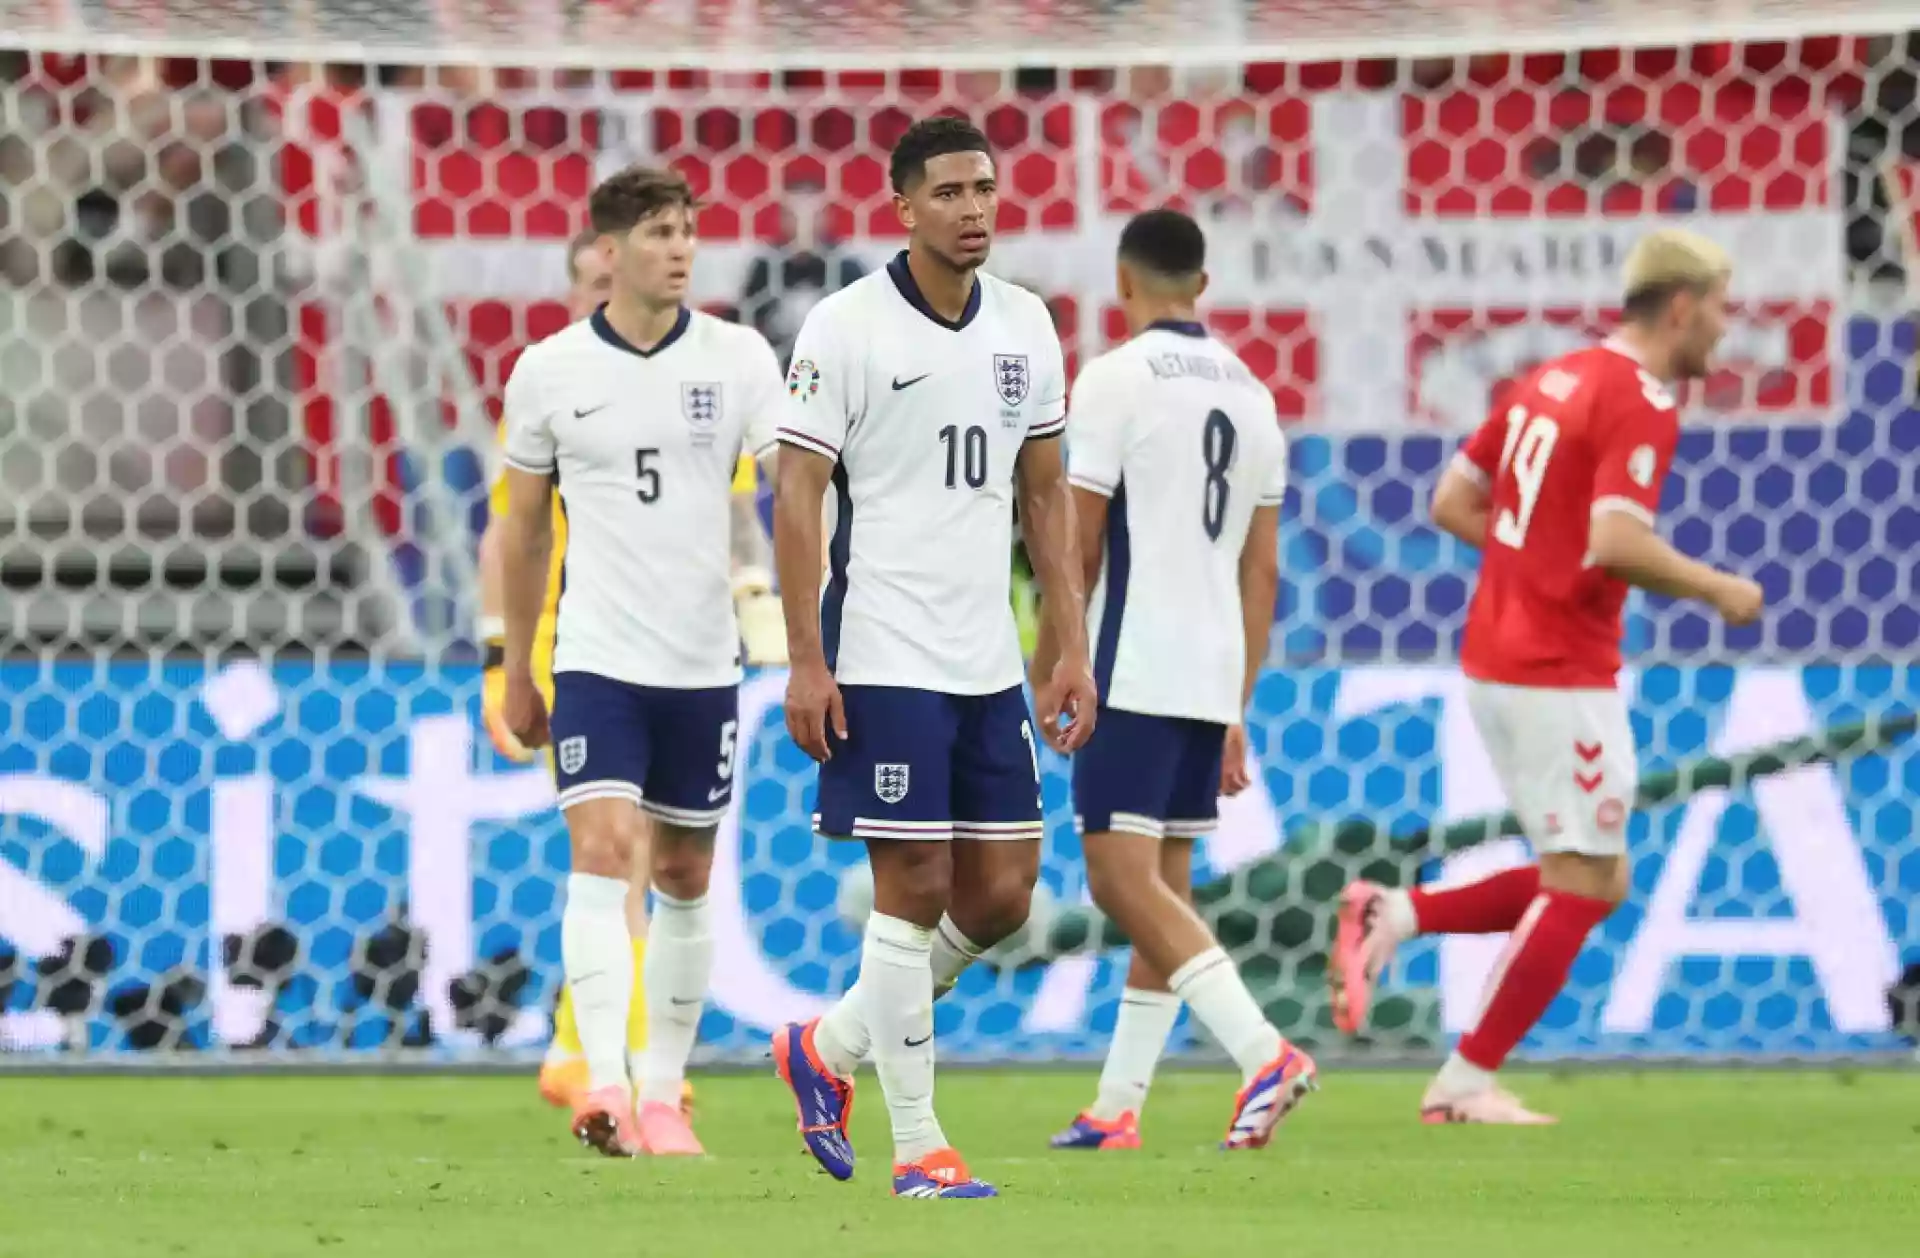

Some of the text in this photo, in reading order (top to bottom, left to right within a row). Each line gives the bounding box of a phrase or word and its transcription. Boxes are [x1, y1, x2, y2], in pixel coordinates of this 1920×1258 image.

[635, 447, 661, 504] 5
[938, 424, 988, 490] 10
[1201, 408, 1238, 542] 8
[1494, 403, 1559, 550] 19
[716, 720, 736, 780] 5
